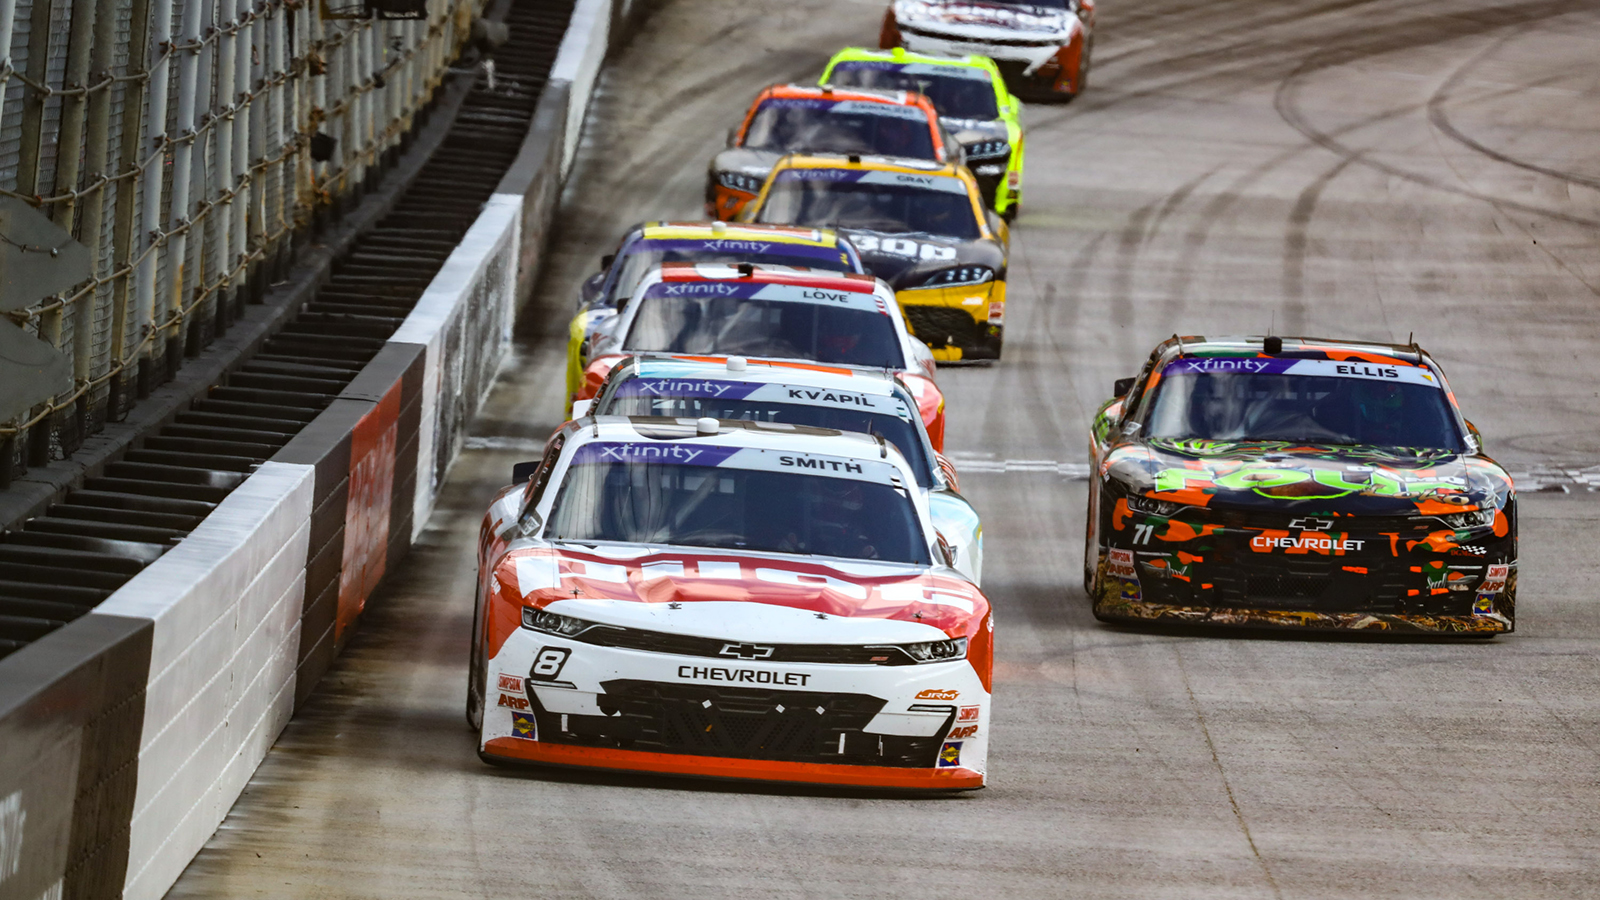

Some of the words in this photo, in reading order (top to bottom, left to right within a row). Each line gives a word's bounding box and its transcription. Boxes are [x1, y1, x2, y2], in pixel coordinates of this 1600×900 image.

[897, 174, 935, 186] GRAY
[704, 240, 771, 253] xfinity
[665, 282, 740, 295] xfinity
[803, 290, 849, 303] LOVE
[1187, 358, 1270, 373] xfinity
[1336, 365, 1399, 378] ELLIS
[639, 379, 732, 397] xfinity
[789, 389, 876, 407] KVAPIL
[601, 443, 704, 463] xfinity
[779, 455, 863, 474] SMITH
[1132, 524, 1154, 545] 71
[1252, 536, 1365, 551] CHEVROLET
[1109, 564, 1134, 576] ARP
[1478, 581, 1505, 591] ARP
[533, 650, 566, 676] 8
[678, 665, 811, 686] CHEVROLET
[498, 693, 529, 709] ARP
[918, 692, 956, 700] JRM
[947, 725, 978, 738] ARP
